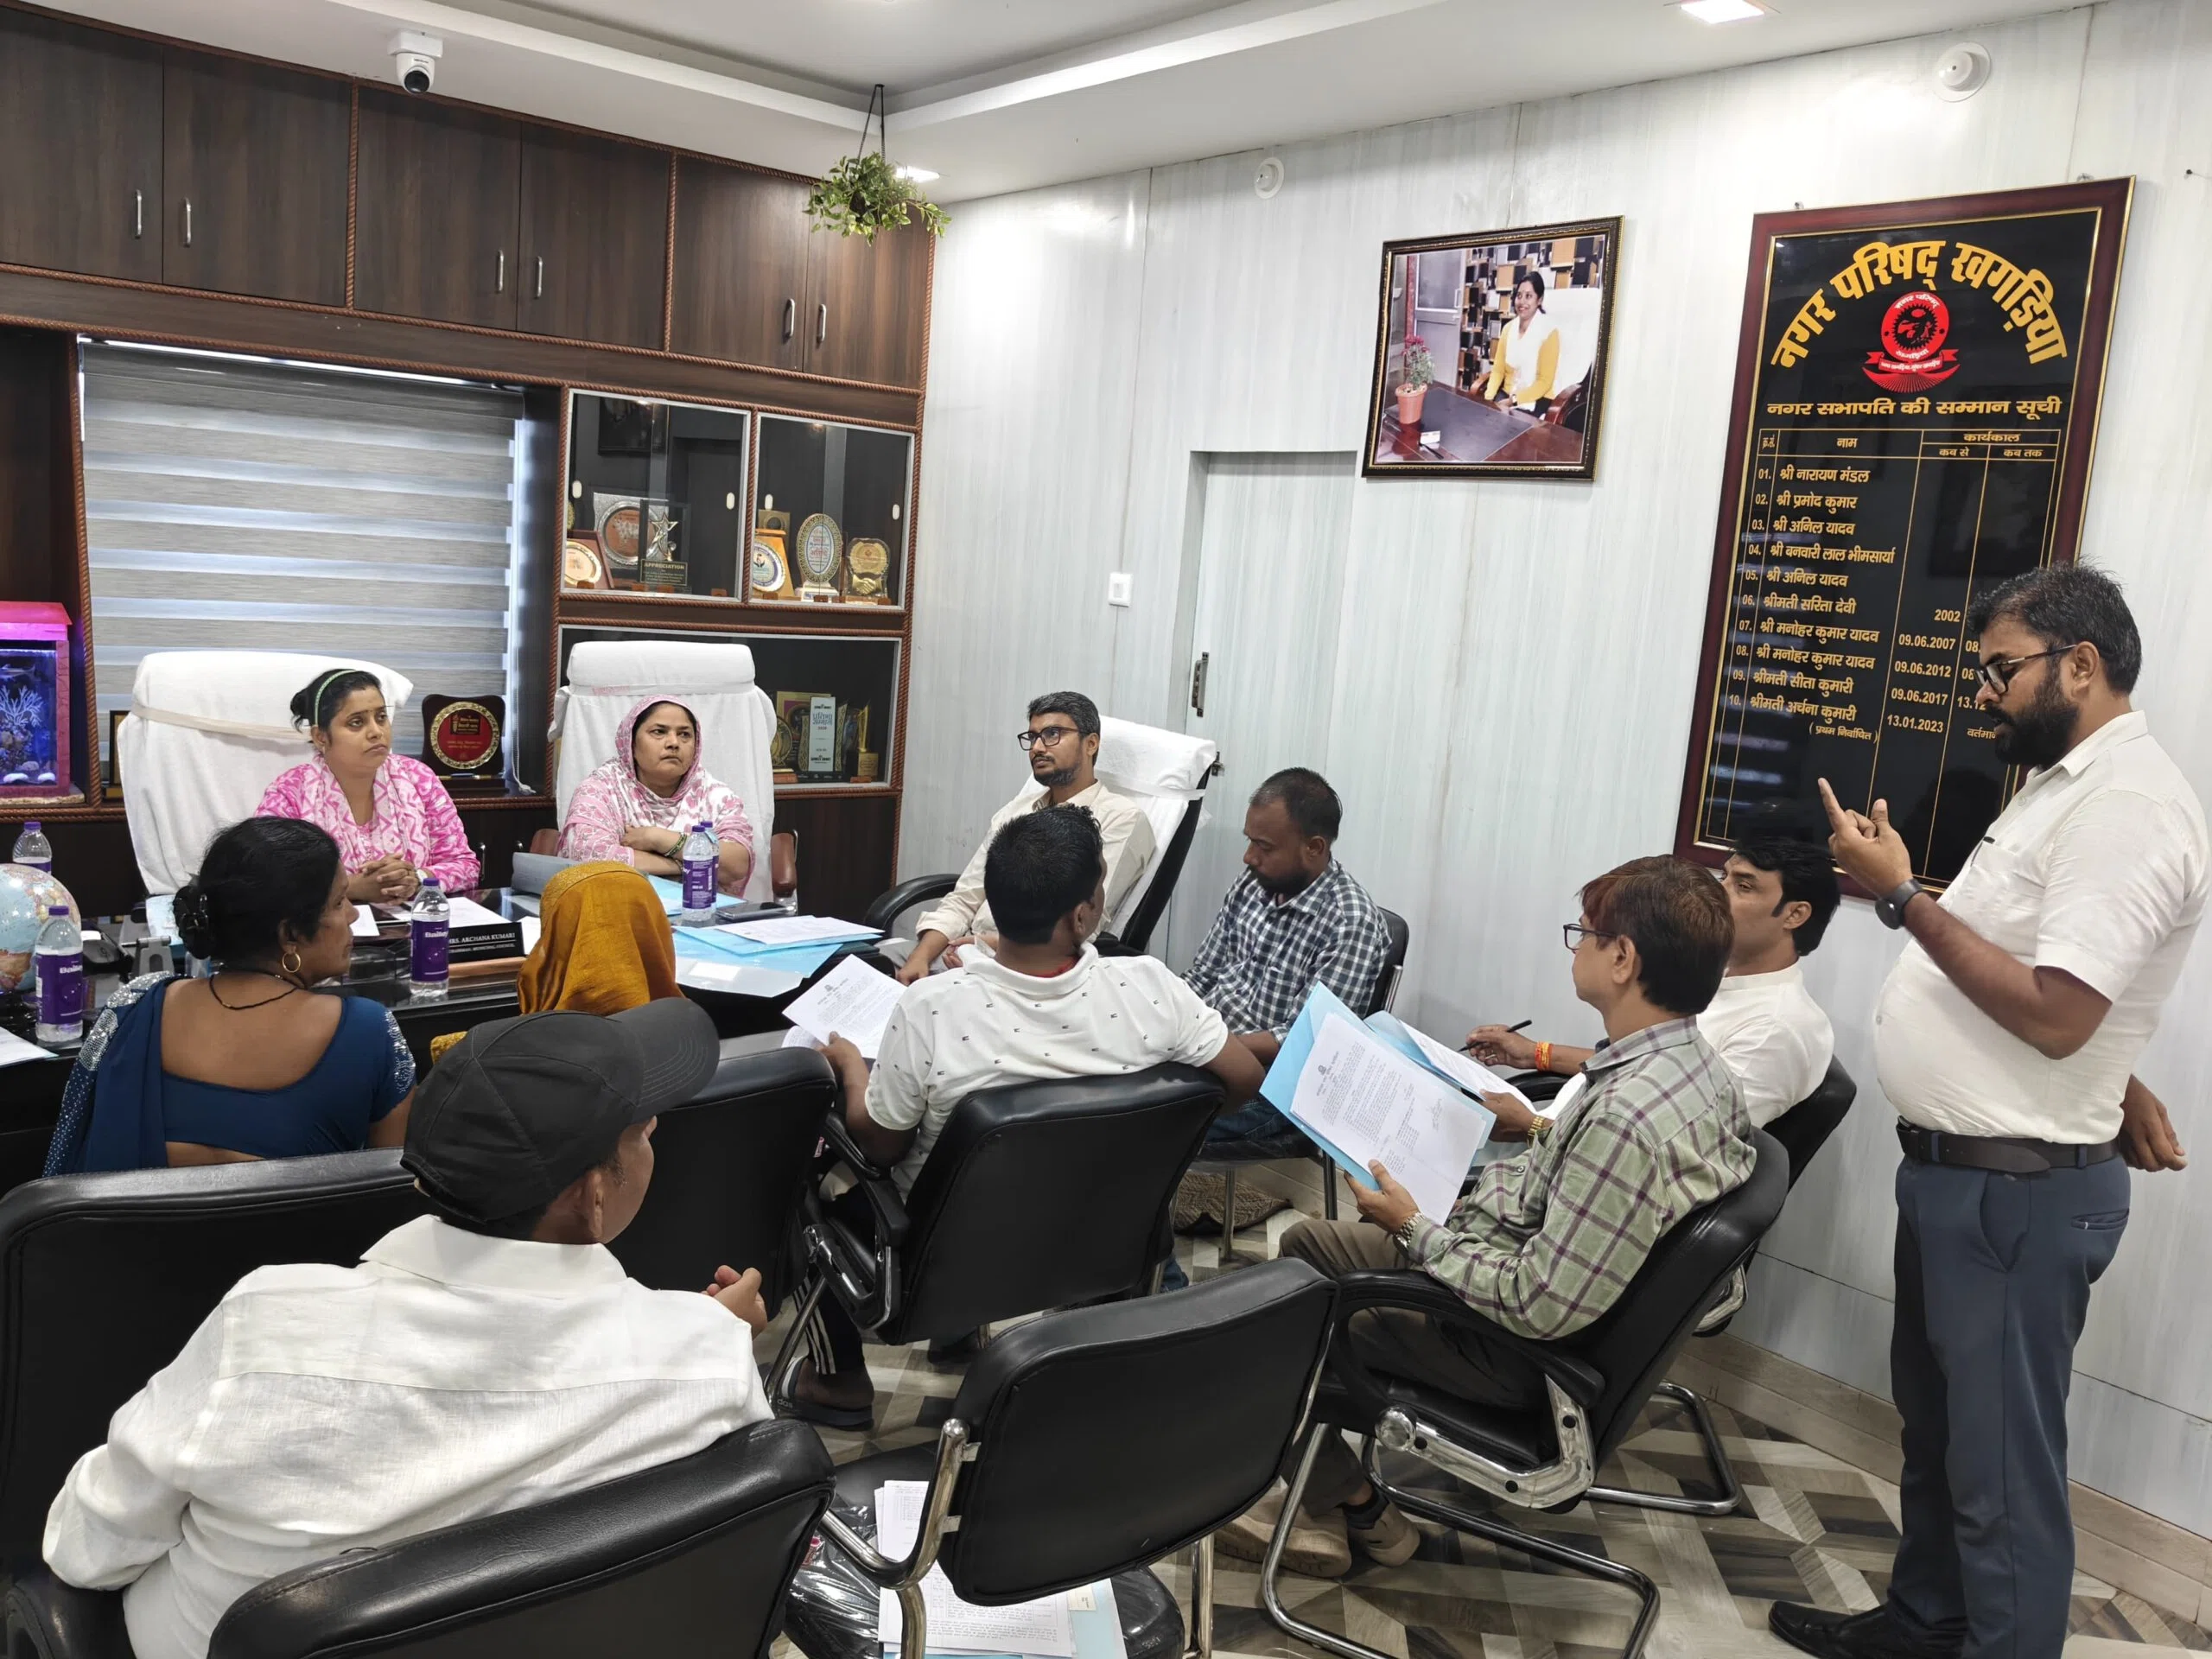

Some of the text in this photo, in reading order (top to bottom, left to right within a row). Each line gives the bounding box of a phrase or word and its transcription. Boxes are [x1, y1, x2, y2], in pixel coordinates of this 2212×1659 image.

[1771, 240, 2068, 368] नगर परिषद् खगड़िया
[1767, 396, 2063, 420] नगर सभापति की सम्मान सूची
[1837, 437, 1858, 448] नाम
[1963, 430, 2021, 443] कार्यकाल
[1960, 446, 1969, 457] से
[2024, 448, 2043, 458] तक
[1758, 464, 1871, 483] 01. श्री नारायण मंडल
[1755, 490, 1858, 514] 02. श्री प्रमोद कुमार
[1751, 515, 1855, 536] 03. श्री अनिल यादव
[1748, 543, 1761, 556] 04.
[1770, 541, 1784, 557] श्री
[1822, 548, 1847, 562] लाल
[1745, 566, 1849, 588] 05. श्री अनिल यादव
[1742, 592, 1857, 615] 06. श्रीमती सरिता देवी
[1934, 608, 1961, 623] 2002
[1739, 617, 1880, 645] 07. श्री मनोहर कुमार यादव
[1898, 633, 1956, 650] 09.06.2007
[1736, 643, 1876, 671] 08. श्री मनोहर कुमार यादव
[1894, 660, 1952, 678] 09.06.2012
[1732, 667, 1854, 698] 09. श्रीमती सीता कुमारी
[1891, 688, 1948, 706] 09.06.2017
[1729, 692, 1857, 724] 10. श्रीमती अर्चना कुमारी
[1887, 714, 1944, 733] 13.01.2023
